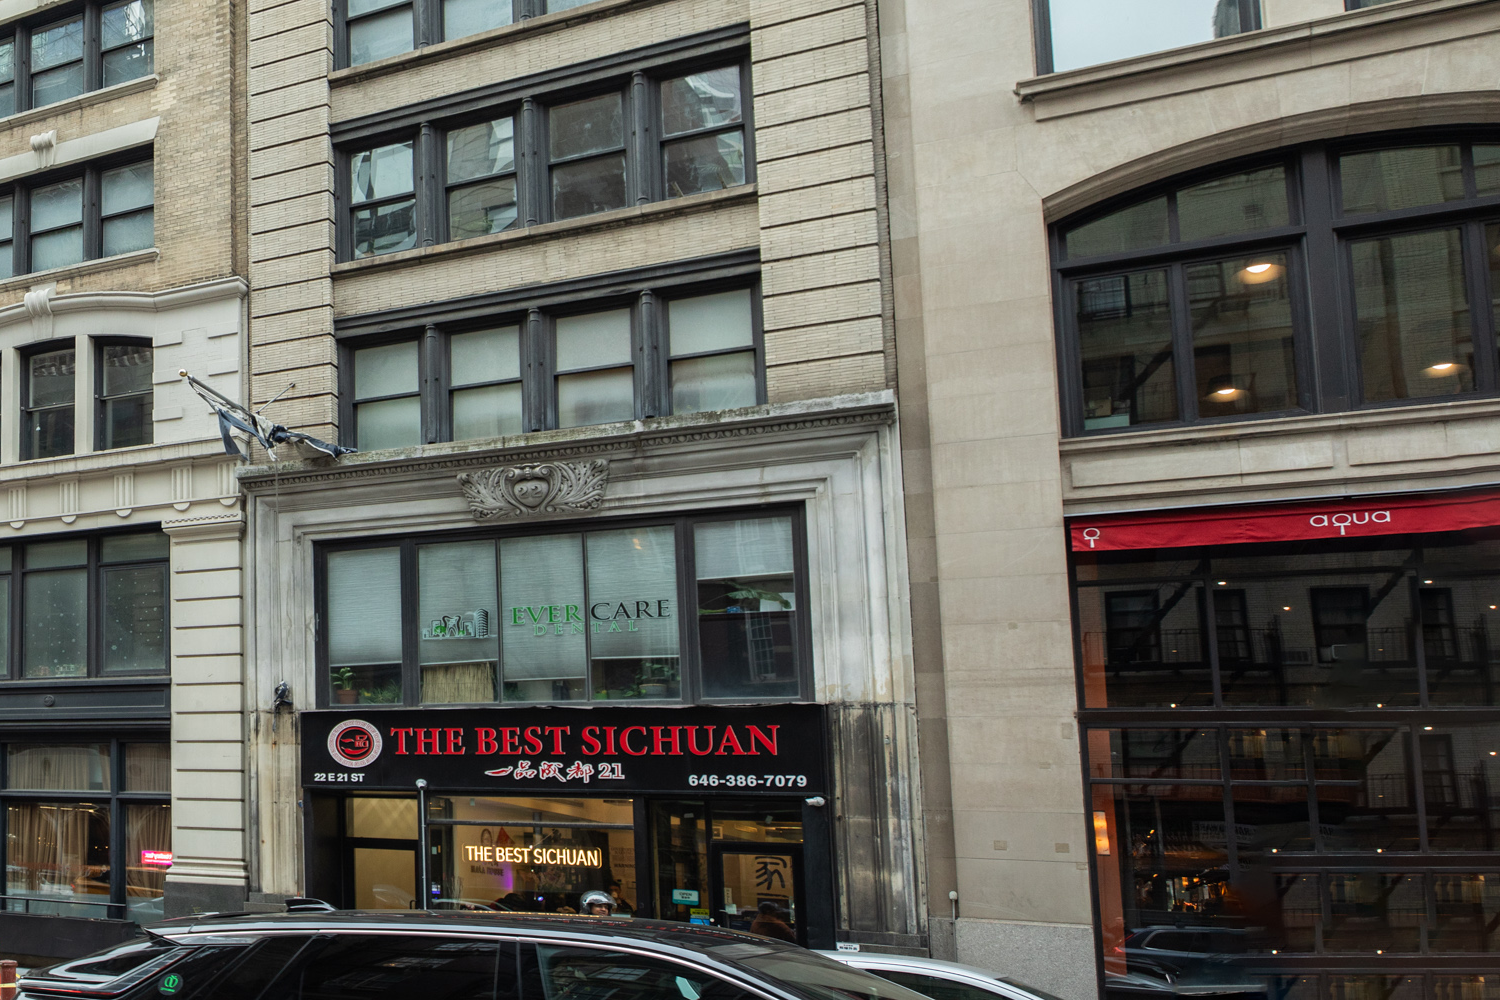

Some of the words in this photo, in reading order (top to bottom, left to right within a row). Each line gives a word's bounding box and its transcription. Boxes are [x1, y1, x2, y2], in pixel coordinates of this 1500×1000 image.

[518, 484, 543, 498] 22
[1309, 510, 1391, 535] aqua
[511, 604, 584, 625] EVER
[591, 599, 671, 620] CARE
[533, 620, 639, 636] DENTAL
[390, 727, 465, 755] THE
[475, 726, 570, 755] BEST
[581, 725, 780, 756] SICHUAN
[314, 773, 326, 782] 22
[328, 773, 335, 781] E
[337, 773, 348, 782] 21
[350, 773, 365, 782] ST
[598, 763, 625, 779] 21
[688, 774, 808, 787] 646-386-7079
[465, 845, 493, 862] THE
[495, 847, 530, 863] BEST
[533, 848, 598, 867] SICHUAN
